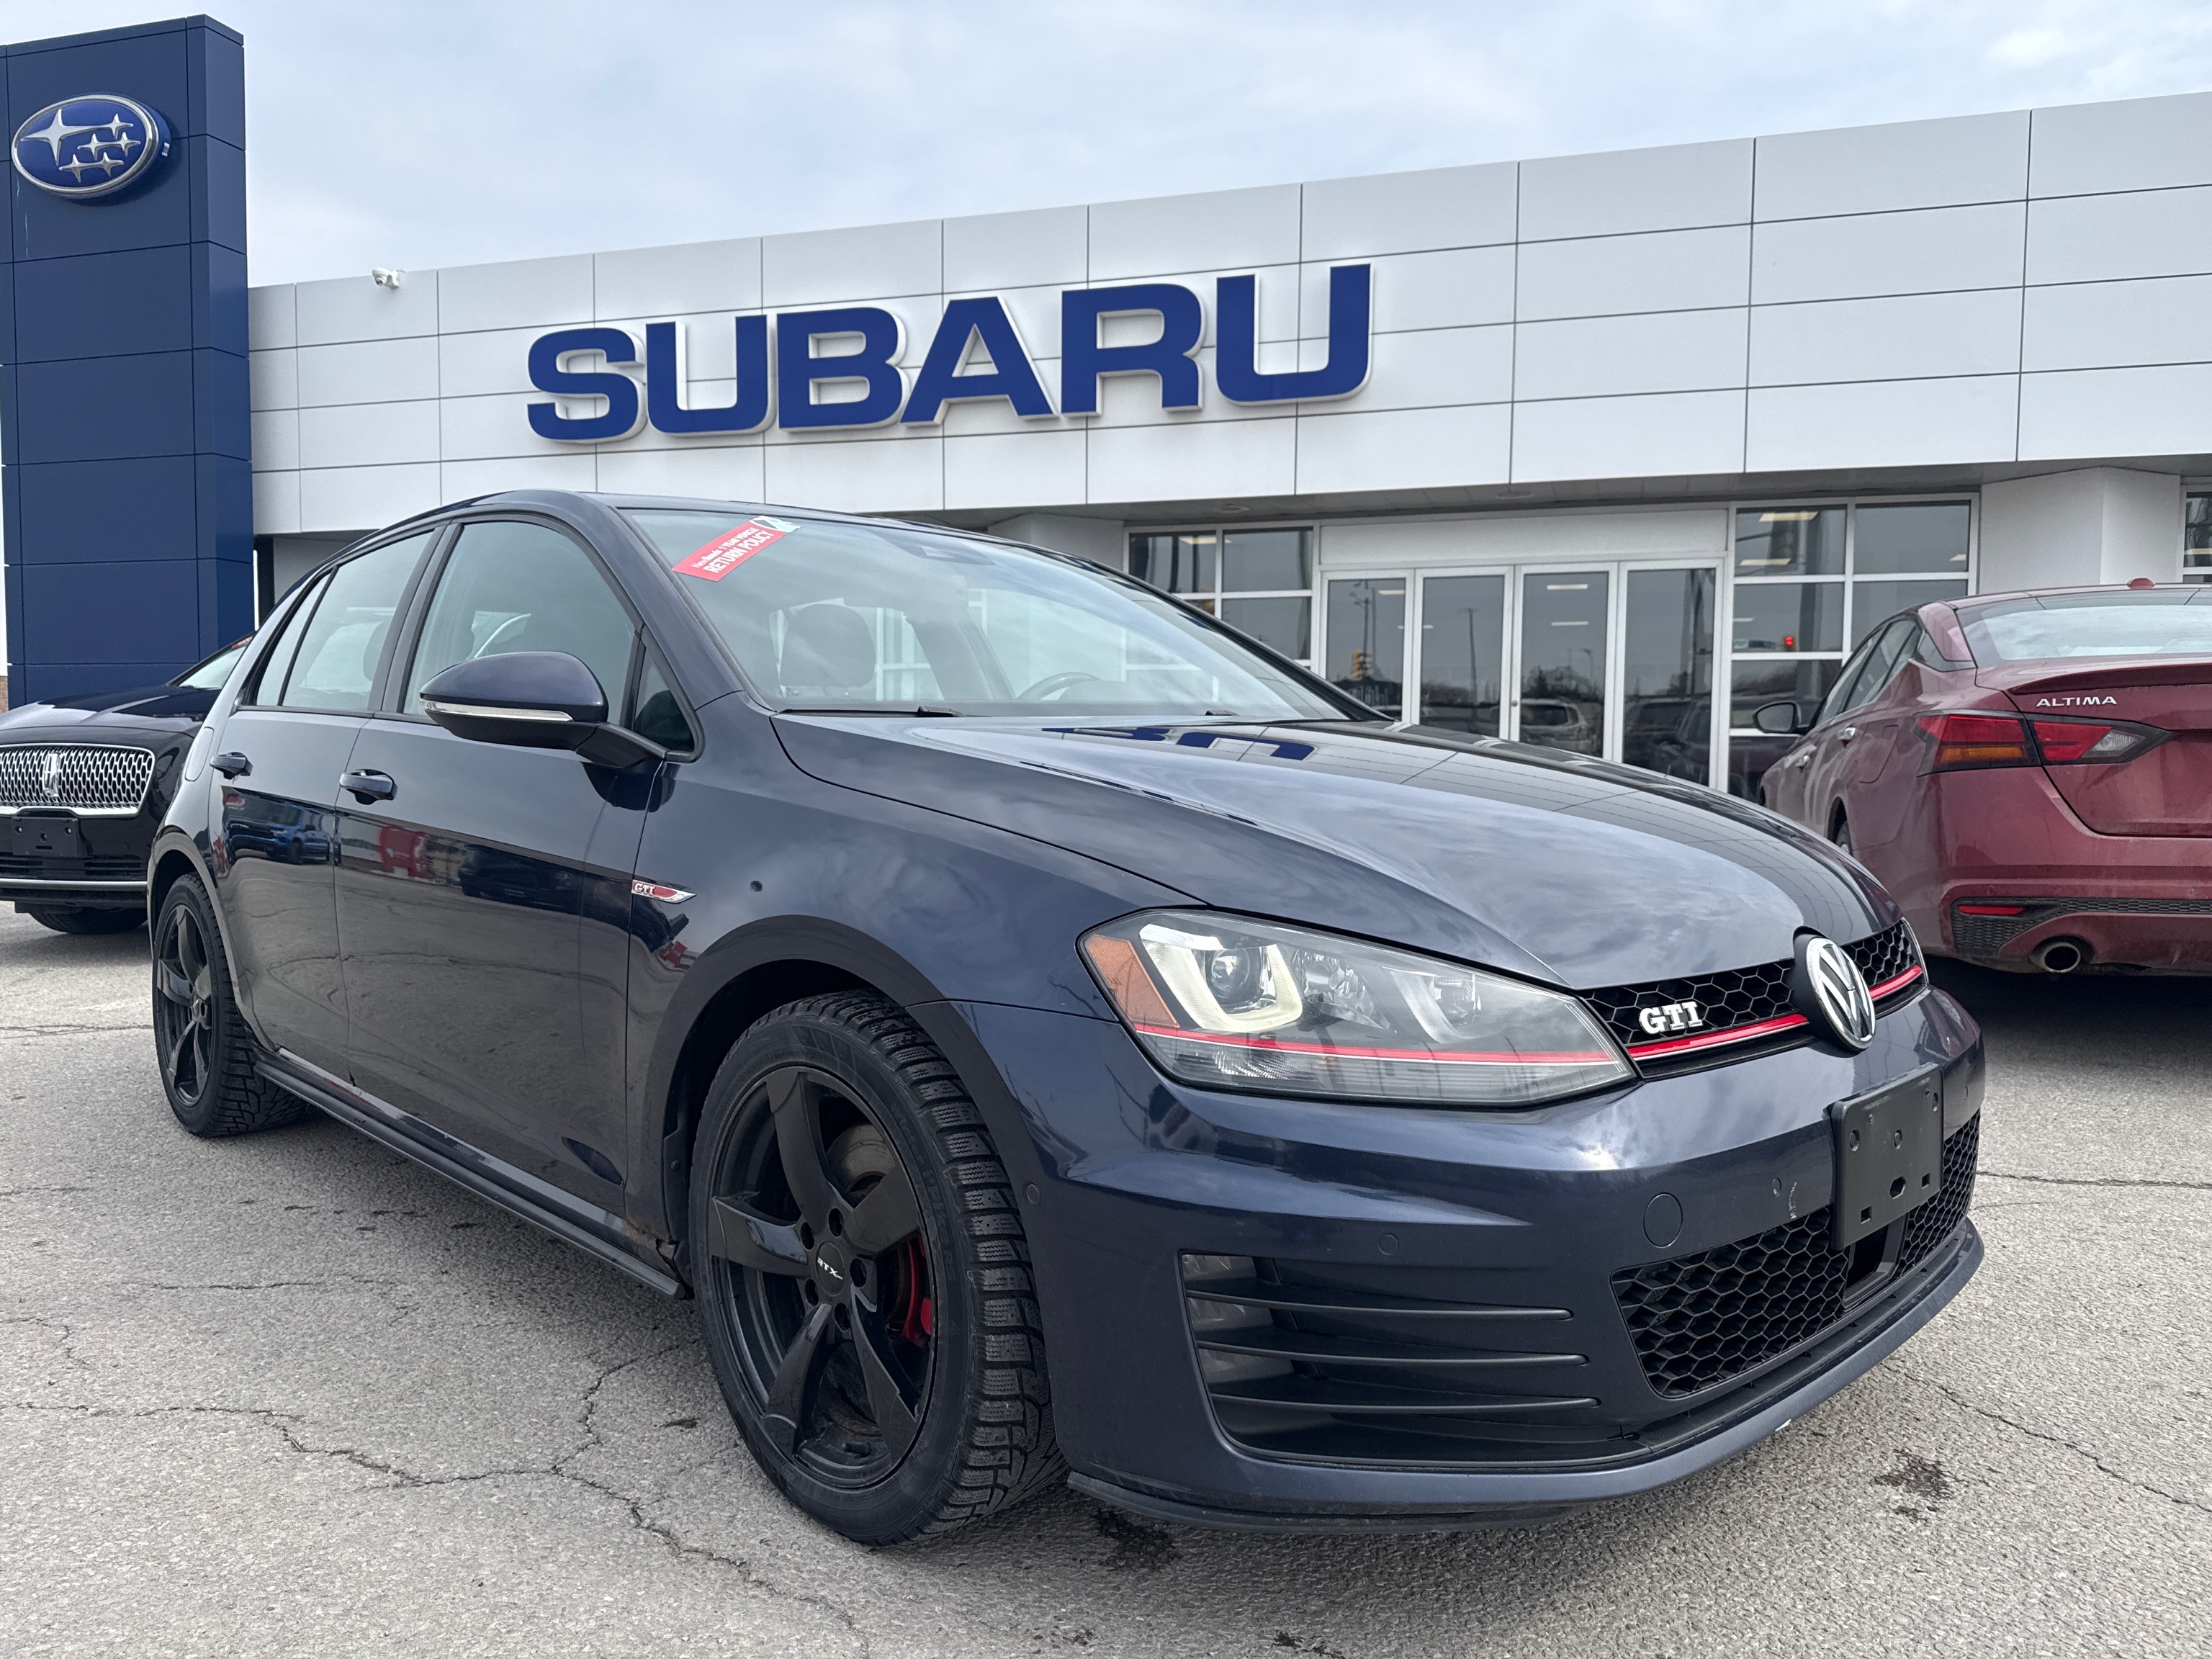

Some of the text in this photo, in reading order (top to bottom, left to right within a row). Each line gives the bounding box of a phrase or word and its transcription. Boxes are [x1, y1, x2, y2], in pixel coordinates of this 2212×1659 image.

[528, 263, 1372, 444] SUBARU
[703, 530, 775, 573] RETURN POLICY
[2036, 696, 2118, 707] ALTIMA
[634, 883, 656, 896] GTI
[1638, 1001, 1704, 1035] GTI
[817, 1256, 843, 1280] RTX
